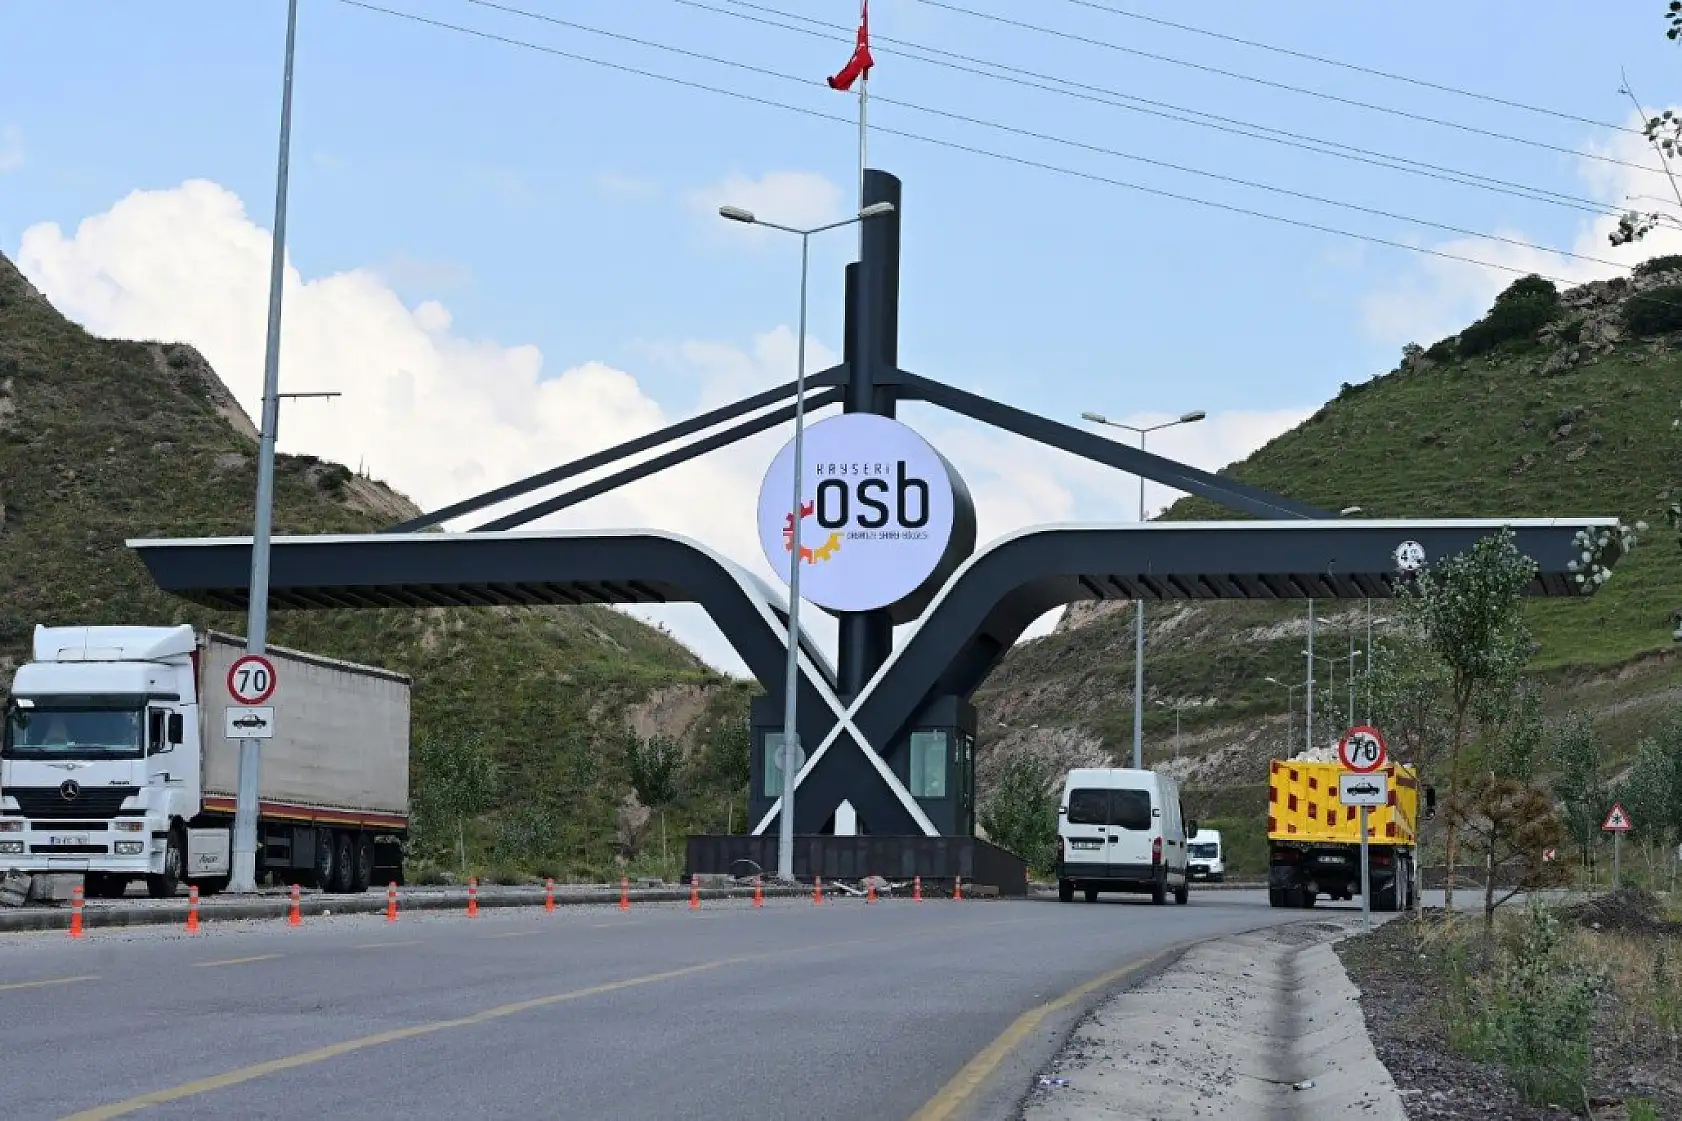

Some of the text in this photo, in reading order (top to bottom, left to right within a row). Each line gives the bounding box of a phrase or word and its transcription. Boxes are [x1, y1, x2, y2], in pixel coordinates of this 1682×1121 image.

[816, 461, 929, 529] osb
[238, 669, 267, 692] 70
[1348, 740, 1377, 762] 70
